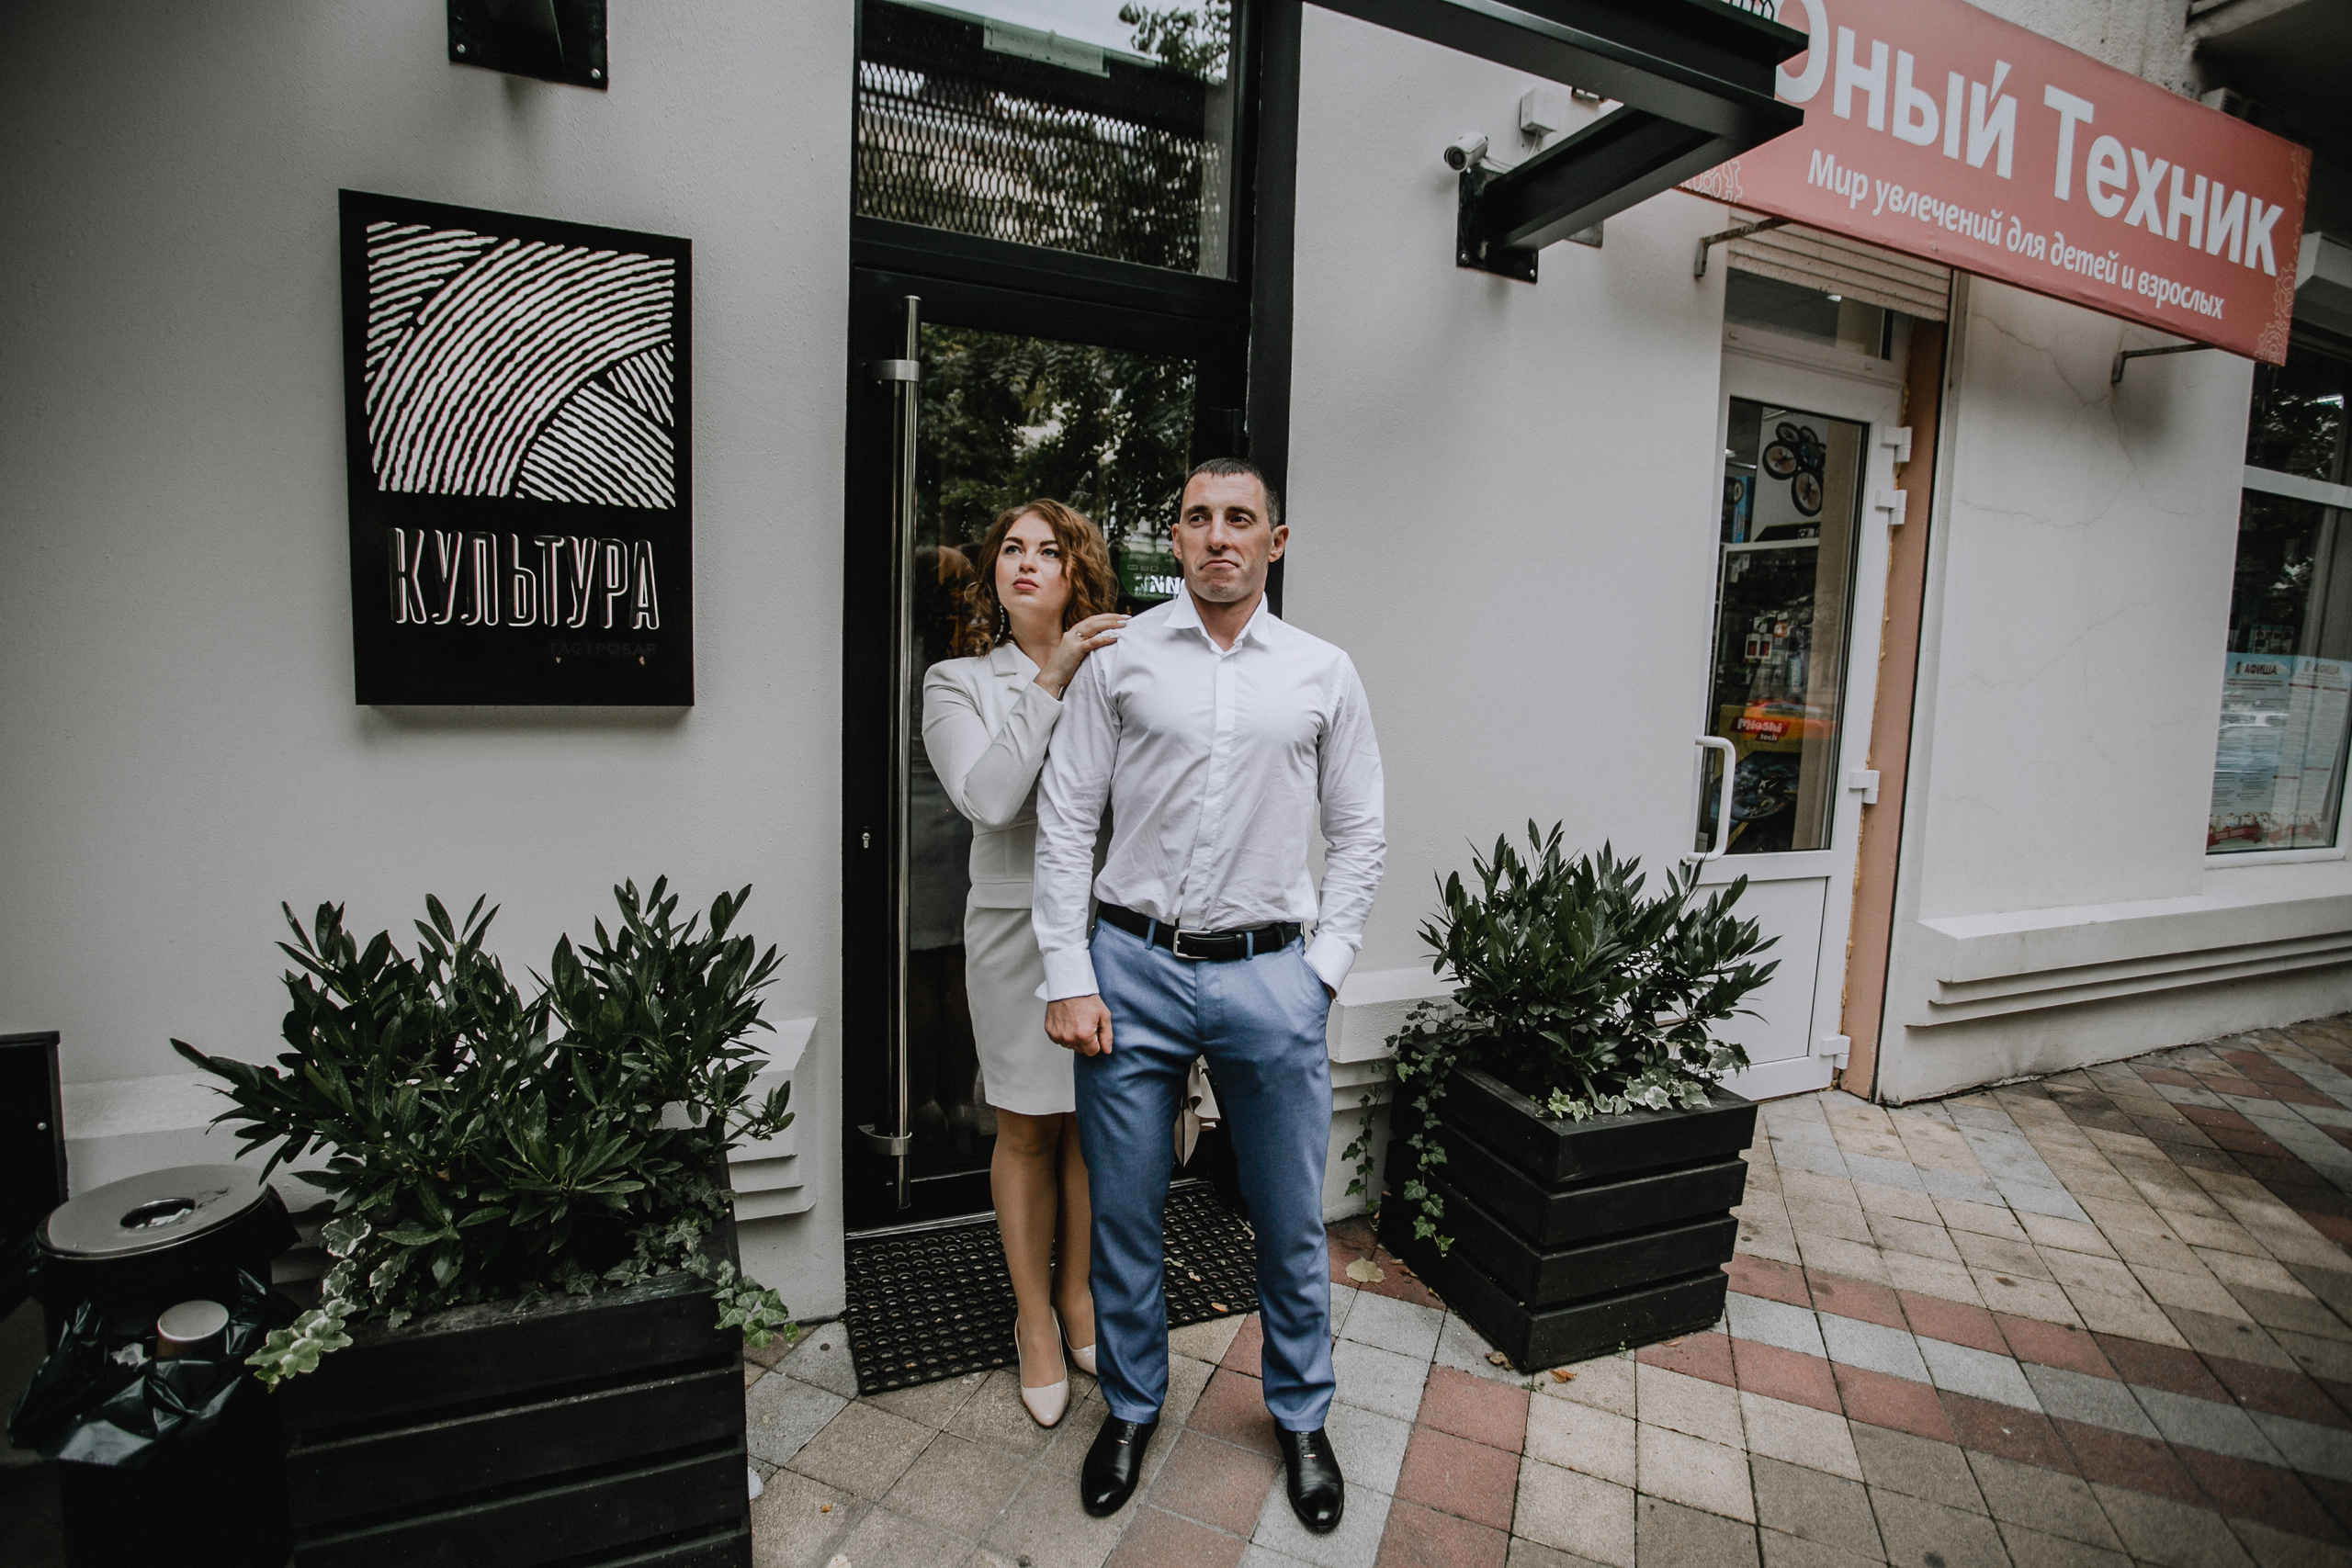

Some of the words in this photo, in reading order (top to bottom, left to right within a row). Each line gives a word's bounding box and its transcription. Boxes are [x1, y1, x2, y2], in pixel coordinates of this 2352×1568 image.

[2043, 84, 2284, 276] Техник
[1807, 149, 1869, 209] Мир
[1872, 179, 2003, 246] увлечений
[2007, 216, 2046, 261] для
[2050, 231, 2120, 285] детей
[2121, 265, 2134, 290] и
[2137, 271, 2224, 320] взрослых
[388, 527, 660, 629] КУЛЬТУРА
[548, 642, 657, 656] ГАСТРОБАР
[2244, 662, 2278, 675] АФИША
